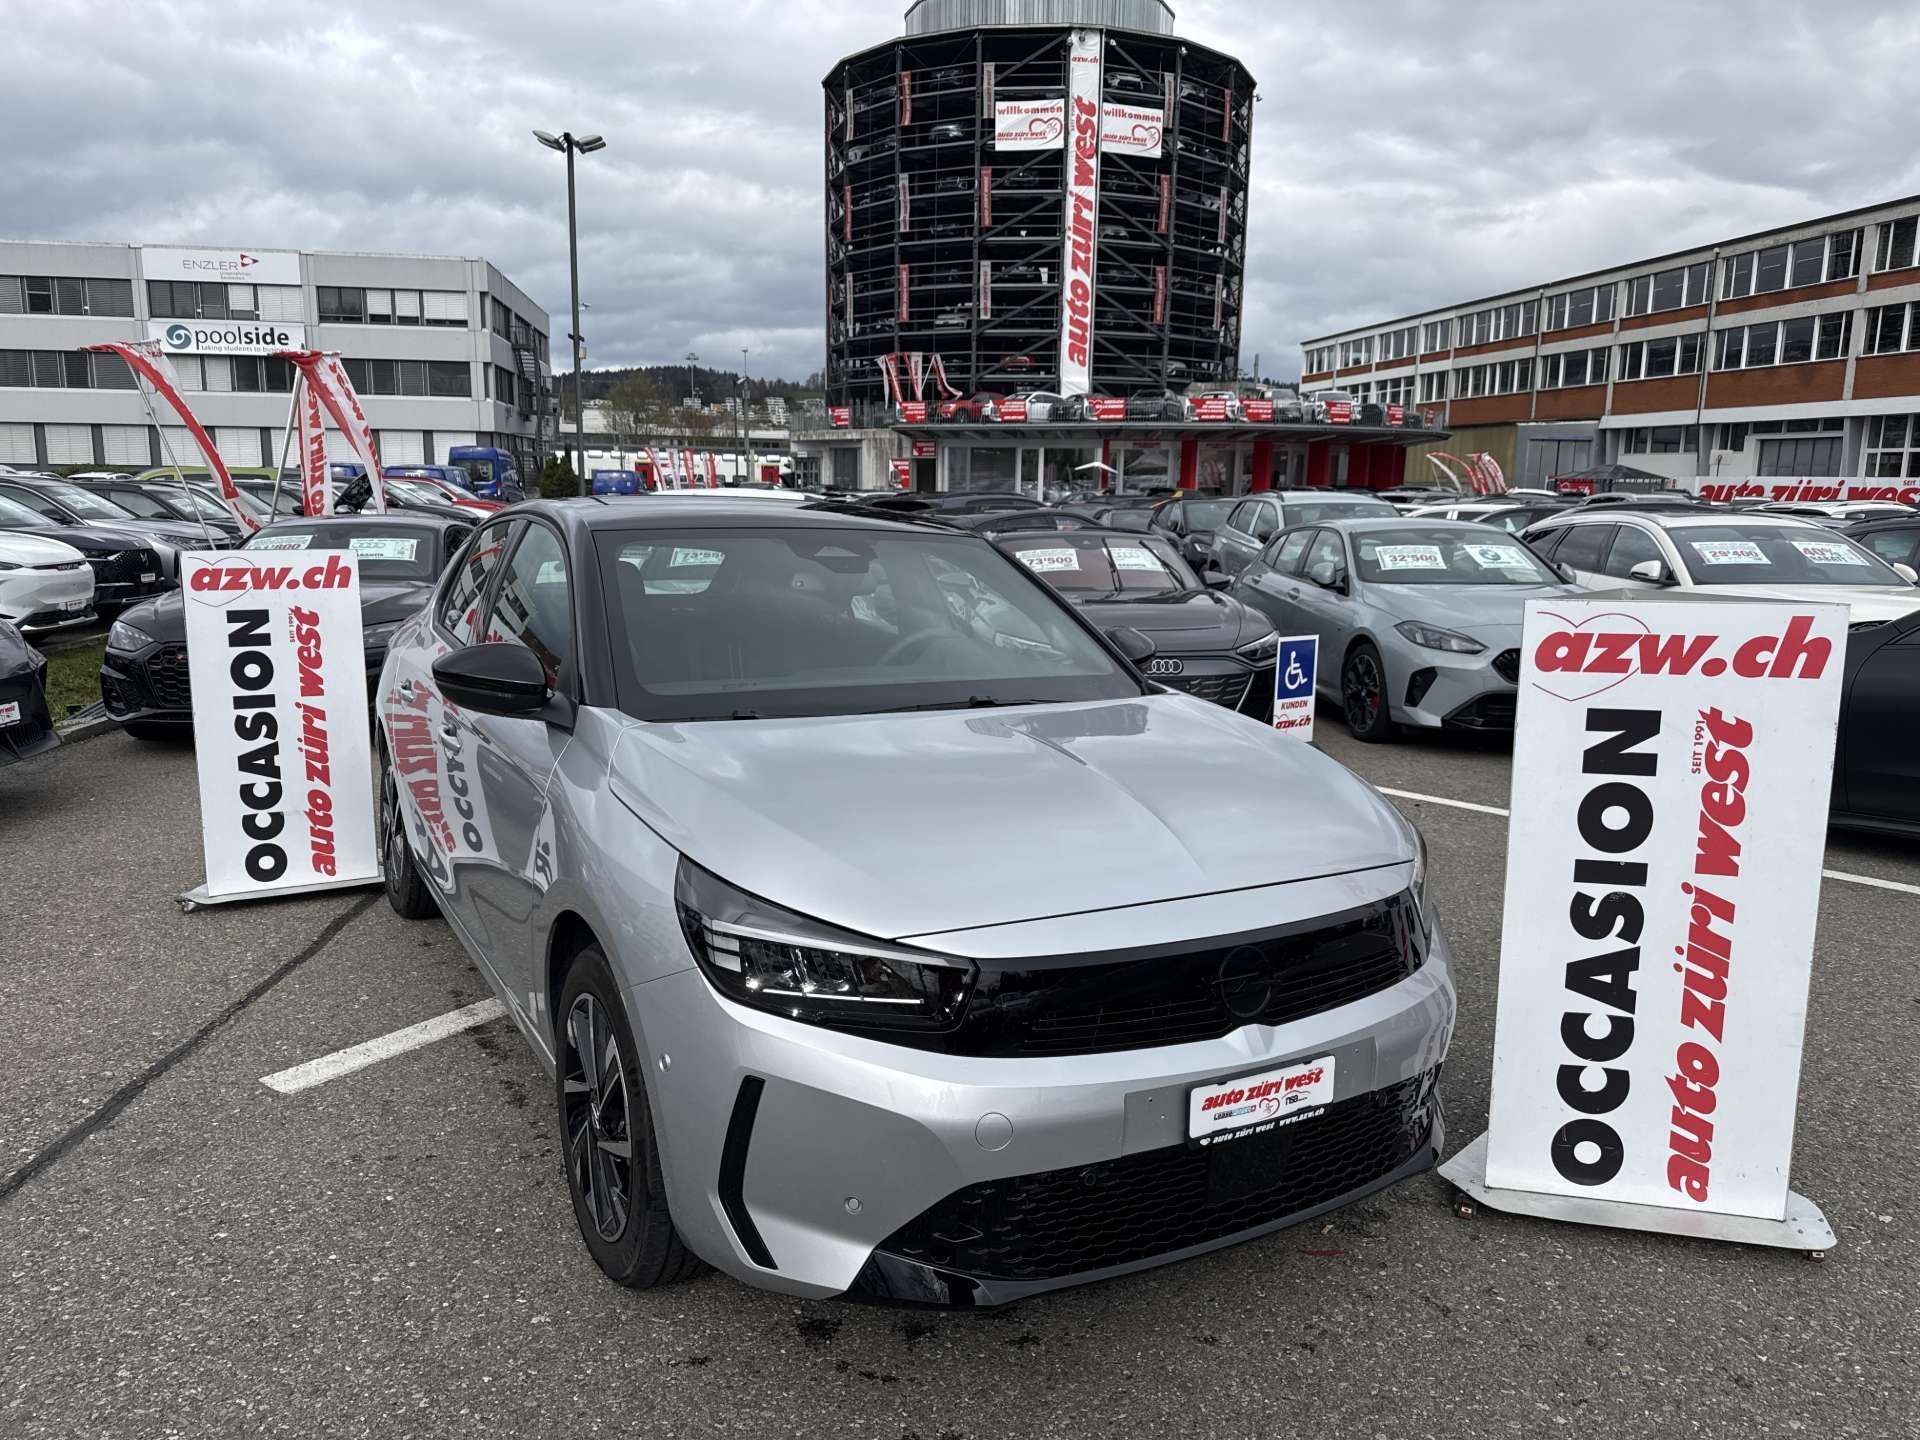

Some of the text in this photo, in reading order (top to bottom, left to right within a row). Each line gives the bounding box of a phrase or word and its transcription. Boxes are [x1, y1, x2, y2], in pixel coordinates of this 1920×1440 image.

[1072, 55, 1098, 64] azw.ch
[997, 106, 1062, 115] willkommen
[1104, 109, 1161, 122] willkommen
[1066, 95, 1097, 368] auto züri west
[183, 260, 238, 270] ENZLER
[195, 326, 289, 350] poolside
[1700, 480, 1764, 503] auto
[1771, 480, 1845, 502] züri
[190, 555, 351, 591] azw.ch
[1027, 557, 1073, 566] 73'500
[1389, 554, 1438, 562] 32'500
[1534, 615, 1832, 679] azw.ch
[1281, 700, 1308, 710] KUNDEN
[1275, 714, 1311, 729] azw.ch
[226, 609, 288, 882] OCCASION
[288, 605, 336, 876] auto züri west
[1691, 720, 1705, 774] SEIT 1991
[1551, 708, 1662, 1186] OCCASION
[1664, 706, 1753, 1202] auto züri west
[1202, 1066, 1323, 1112] auto züri west
[1212, 1107, 1325, 1143] auto züri west www.azw.ch
